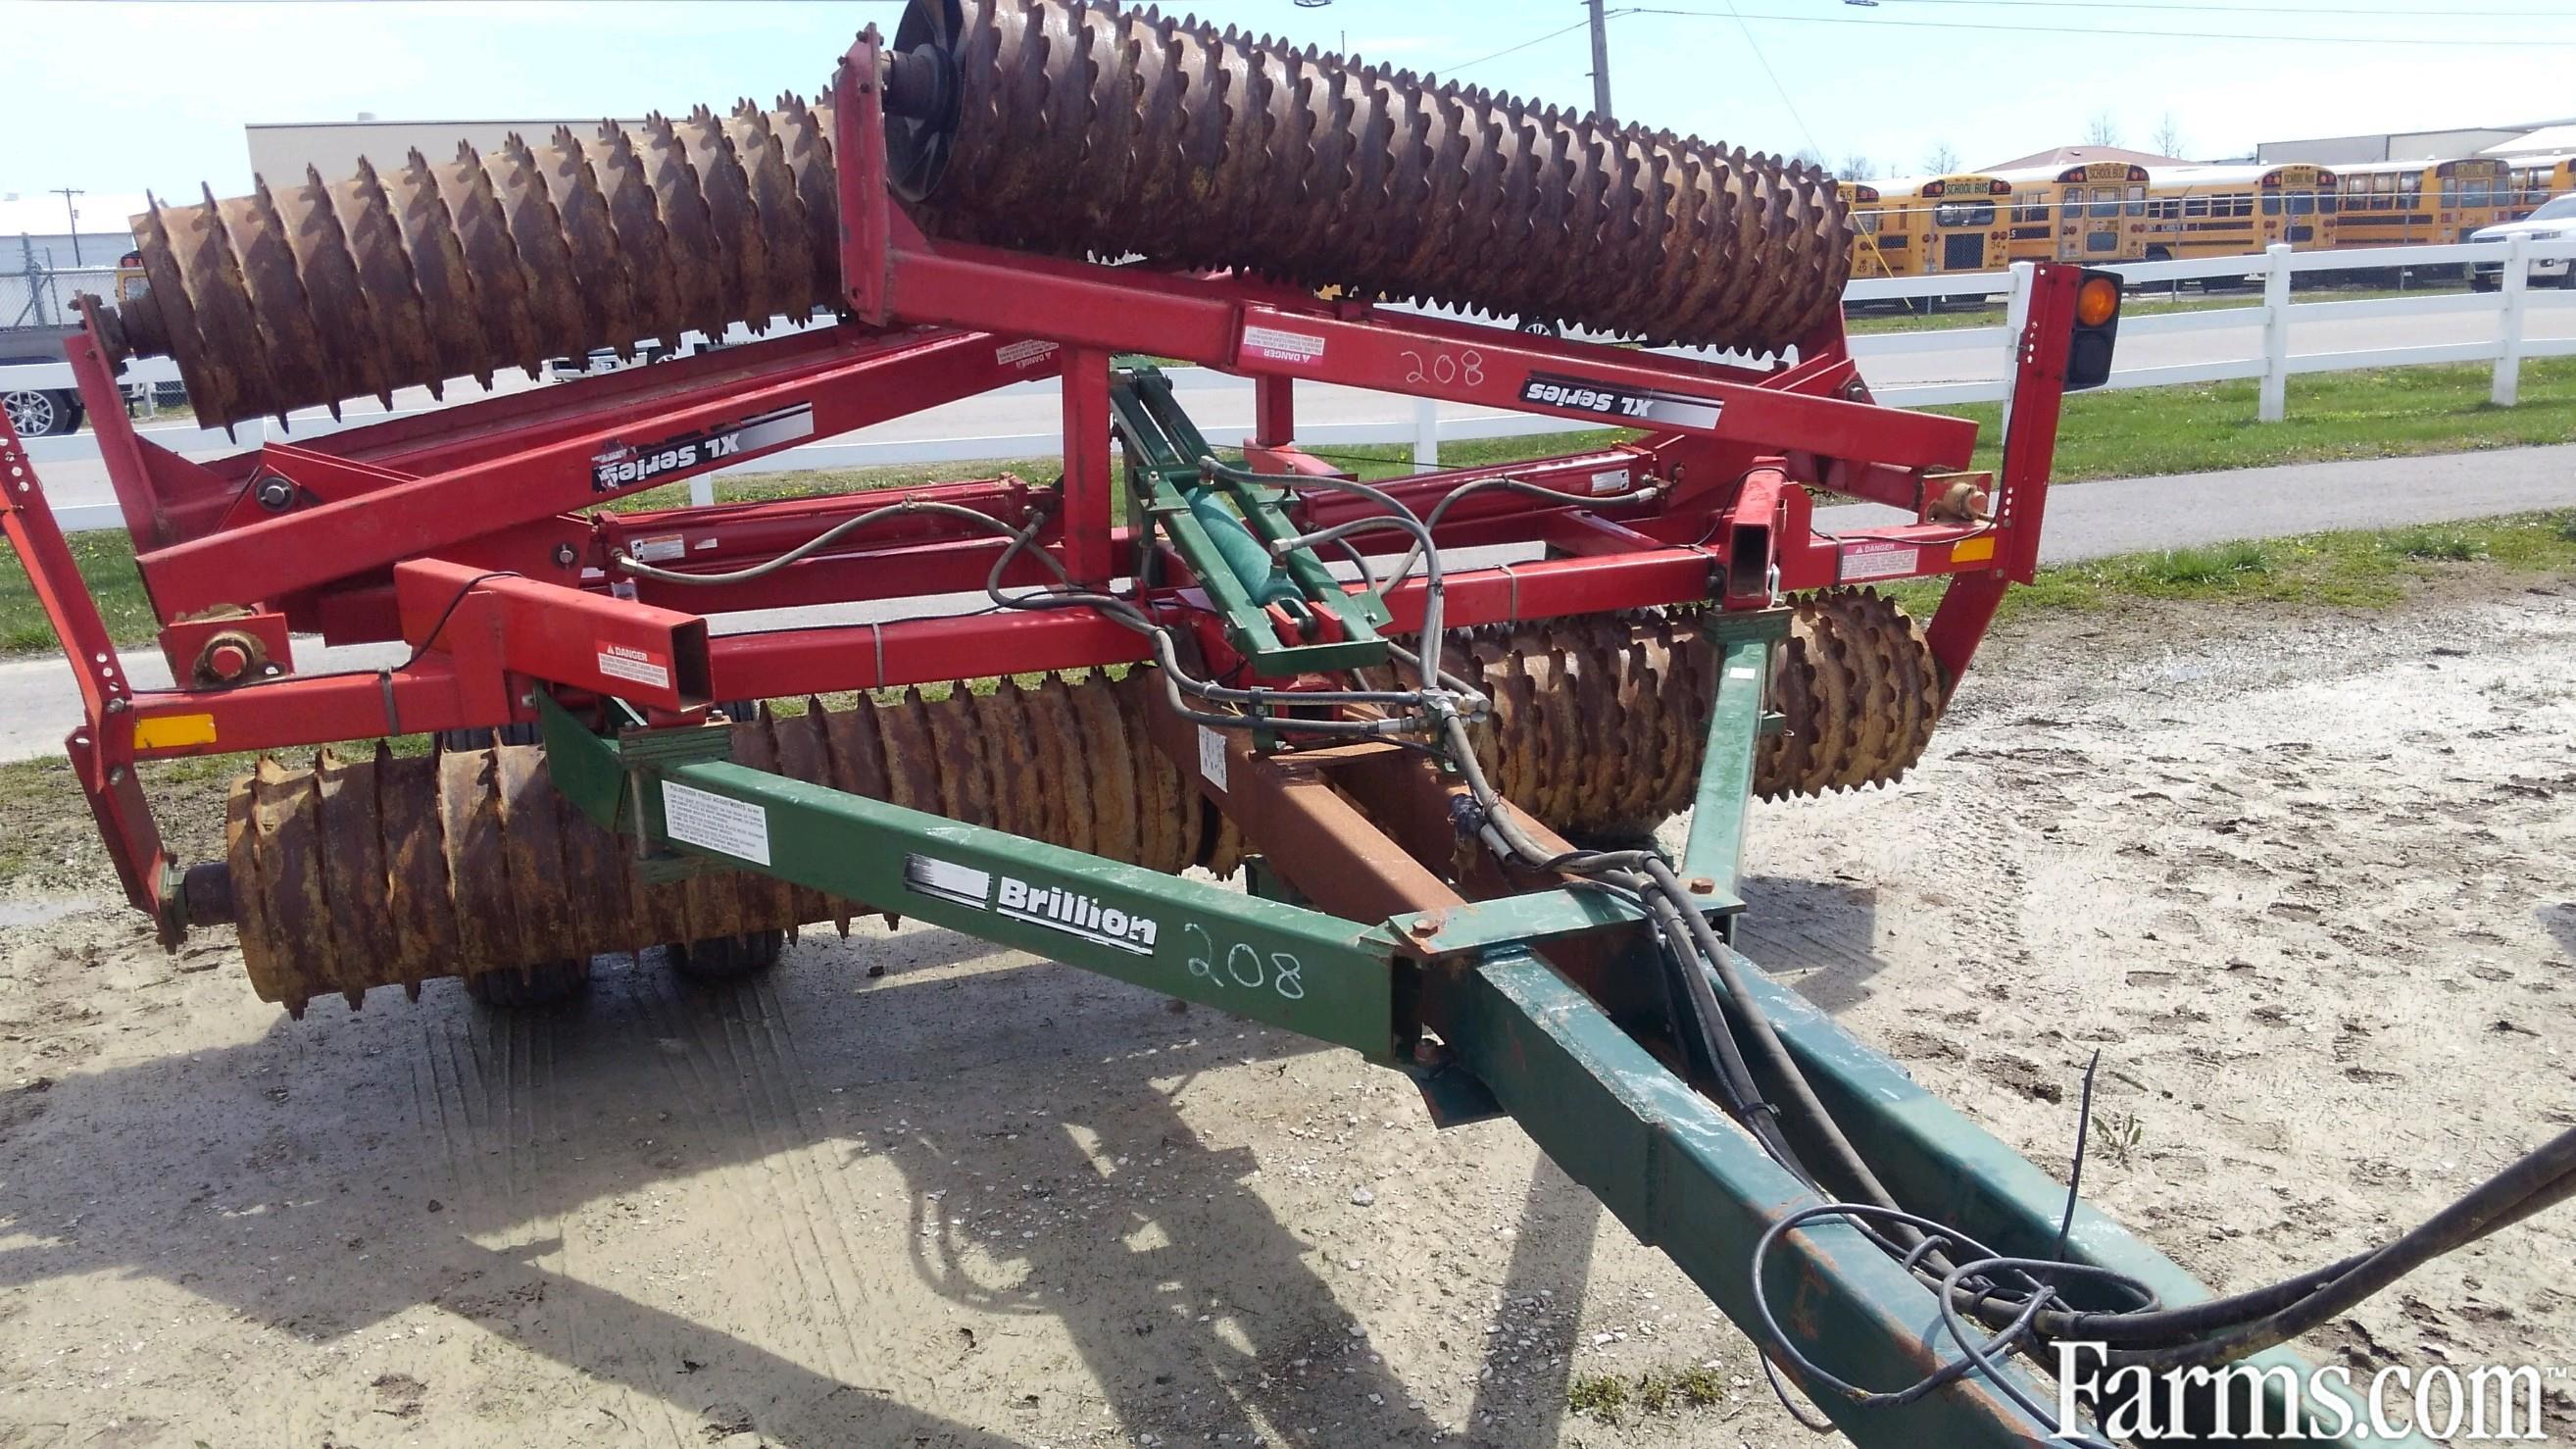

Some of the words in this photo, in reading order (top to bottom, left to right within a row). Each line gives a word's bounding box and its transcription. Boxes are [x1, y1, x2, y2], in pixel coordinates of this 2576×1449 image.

[1946, 182, 1971, 196] SCHOOL
[1974, 181, 1989, 194] BUS
[1016, 353, 1045, 369] DANGER
[1263, 348, 1301, 362] DANGER
[1401, 350, 1484, 385] 208
[1526, 382, 1614, 413] Series
[1621, 396, 1655, 418] XL
[706, 432, 739, 459] XL
[599, 444, 696, 489] Series
[1864, 543, 1895, 553] DANGER
[615, 646, 648, 662] DANGER
[998, 876, 1158, 945] Brillion
[1184, 923, 1305, 999] 208
